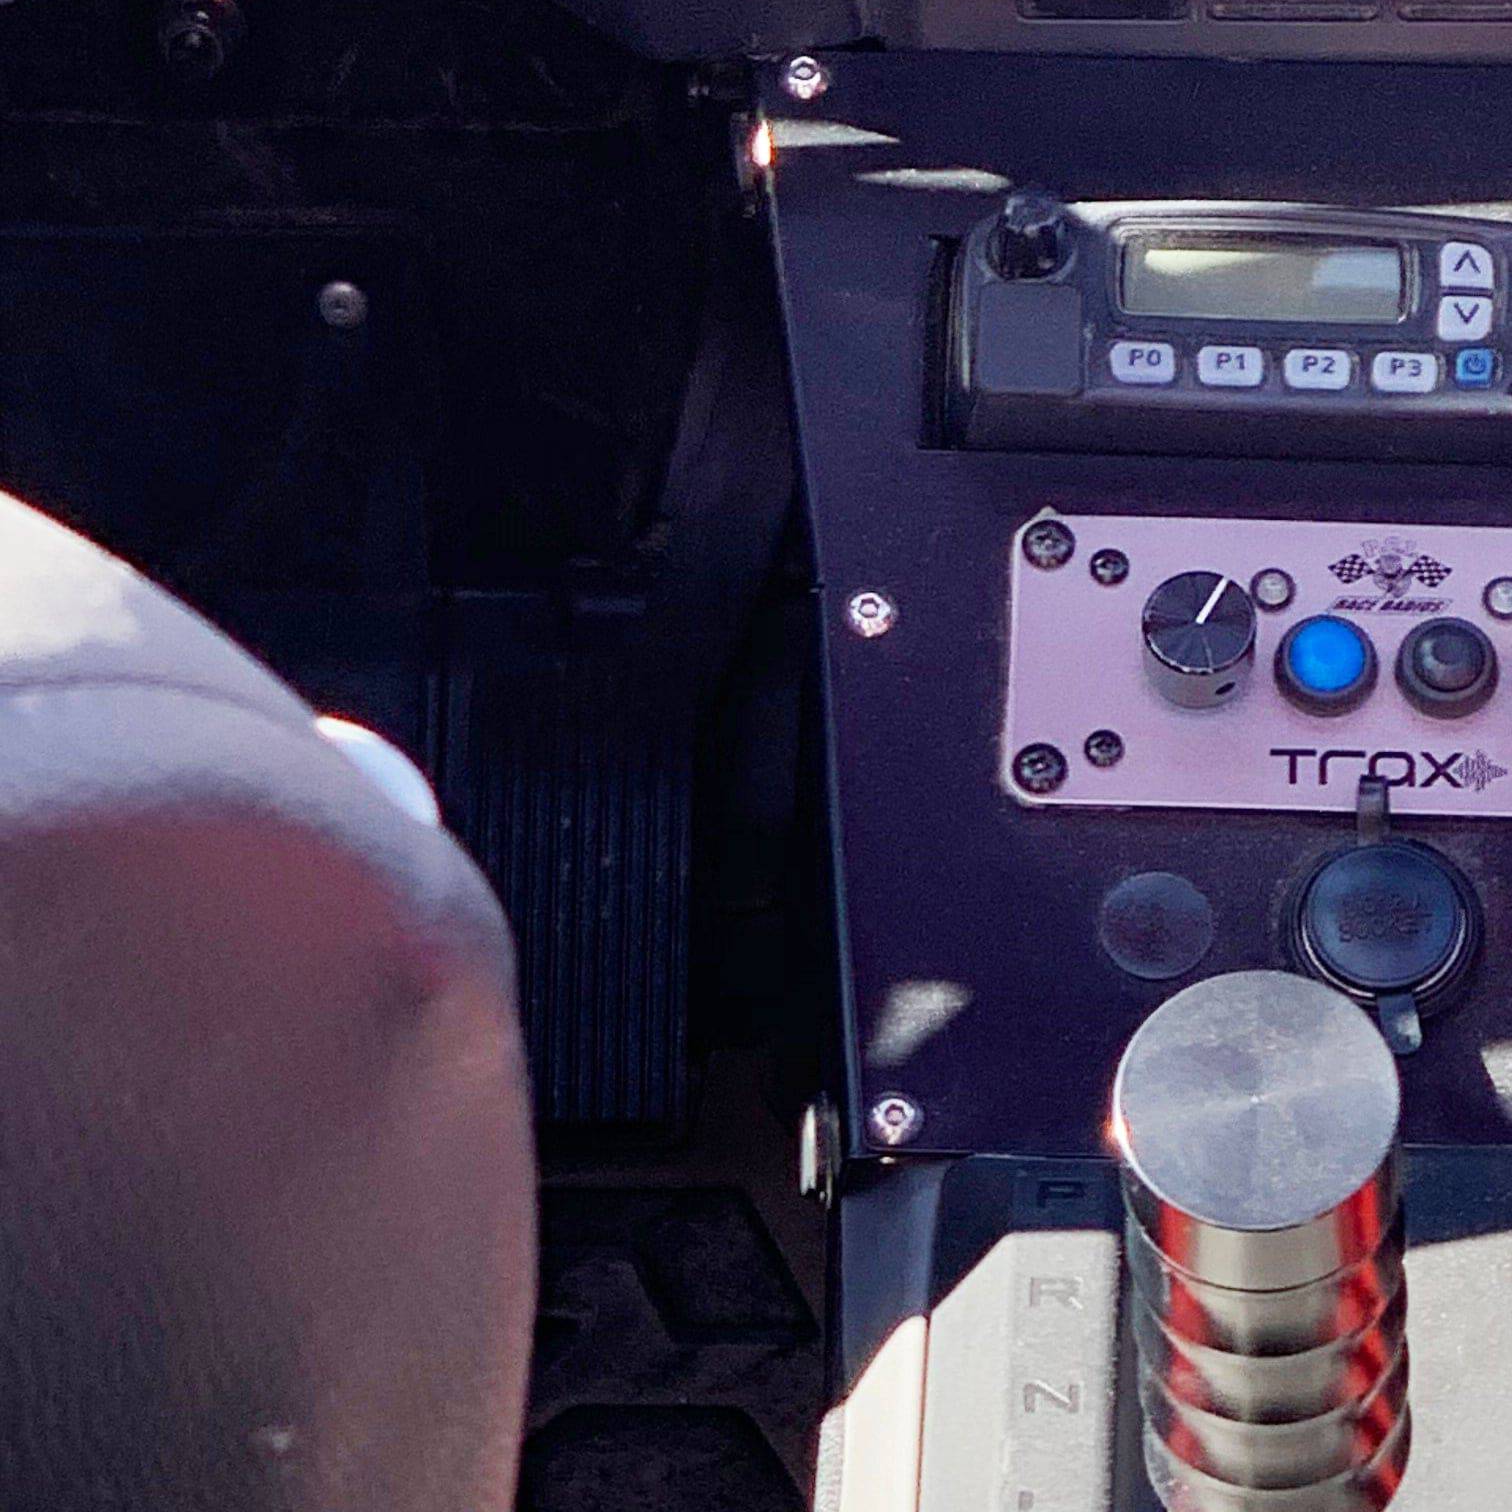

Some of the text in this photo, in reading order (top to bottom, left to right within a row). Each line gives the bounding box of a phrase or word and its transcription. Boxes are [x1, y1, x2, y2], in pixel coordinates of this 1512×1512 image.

[1216, 352, 1245, 371] P1
[1302, 355, 1335, 374] P2
[1390, 358, 1422, 377] P3
[1029, 1276, 1084, 1309] R
